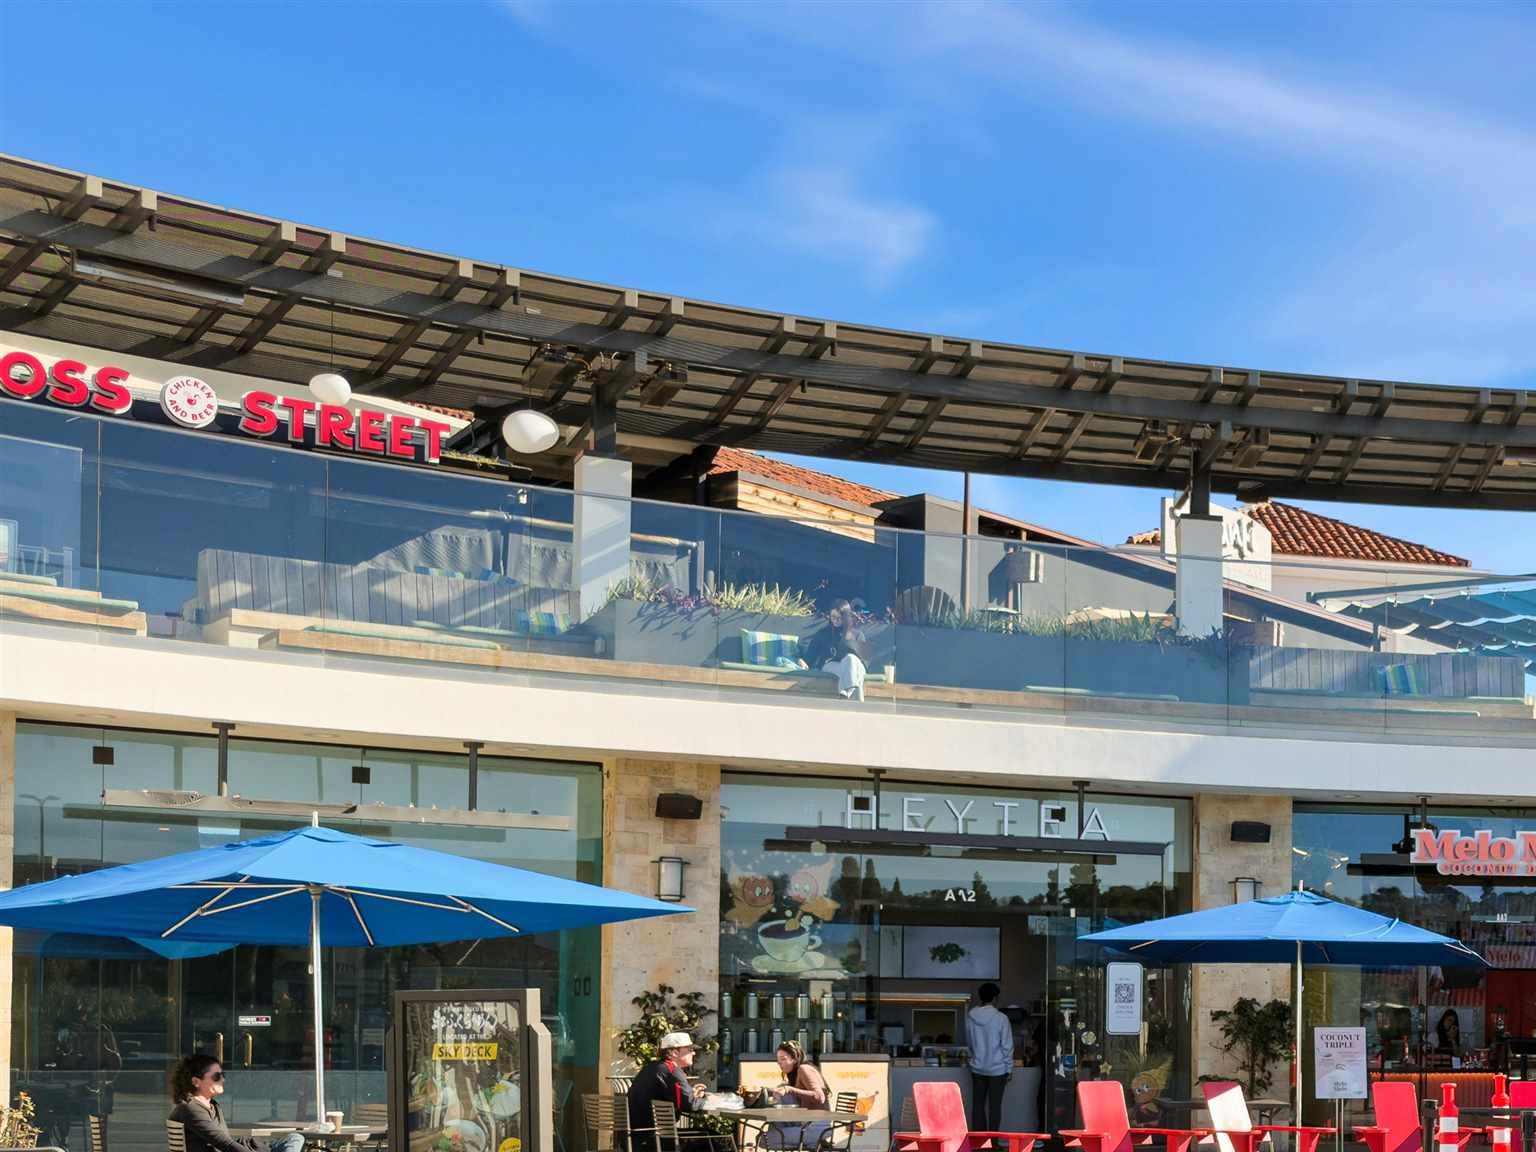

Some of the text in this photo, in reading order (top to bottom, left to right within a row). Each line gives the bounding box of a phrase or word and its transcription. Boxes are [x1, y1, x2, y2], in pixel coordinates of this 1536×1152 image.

[169, 379, 214, 399] CHICKEN
[169, 399, 215, 421] AND BEER
[239, 390, 451, 463] STREET
[847, 794, 1112, 841] HEYTEA
[1412, 830, 1516, 862] Melo
[1441, 863, 1519, 875] COCONUT
[438, 1045, 459, 1058] SKY
